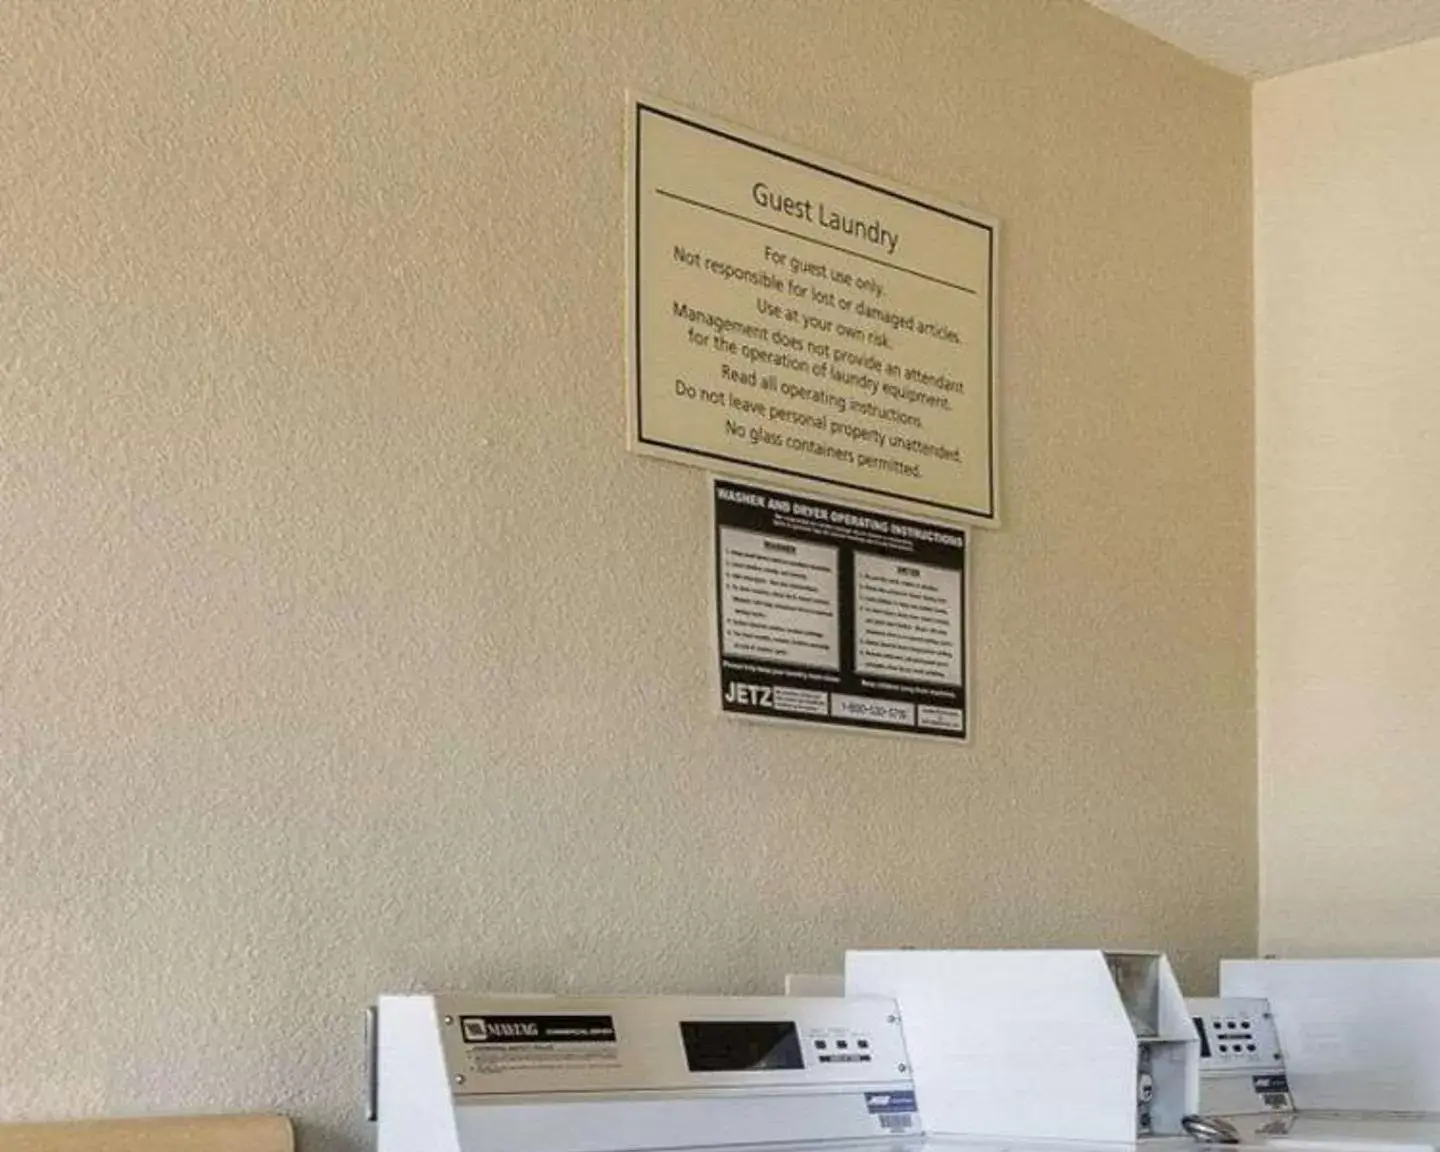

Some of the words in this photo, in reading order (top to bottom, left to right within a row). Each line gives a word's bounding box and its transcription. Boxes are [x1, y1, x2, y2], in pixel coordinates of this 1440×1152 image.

[752, 182, 813, 222] Guest
[818, 204, 899, 255] Laundry
[673, 245, 701, 268] Not
[704, 257, 785, 293] responsible
[788, 278, 808, 299] for
[811, 285, 836, 309] lost
[838, 297, 852, 311] or
[855, 301, 914, 331] damaged
[764, 245, 787, 266] For
[790, 256, 828, 279] guest
[830, 269, 852, 287] use
[673, 300, 768, 342] Management
[771, 331, 803, 351] does
[807, 342, 830, 359] not
[832, 348, 883, 372] provide
[885, 361, 901, 377] an
[757, 297, 782, 320] Use
[784, 307, 799, 323] at
[802, 313, 833, 333] your
[836, 323, 865, 341] own
[688, 327, 709, 347] for
[713, 333, 737, 355] the
[741, 343, 811, 372] operation
[812, 361, 828, 378] of
[830, 363, 880, 396] laundry
[721, 363, 757, 388] Read
[760, 374, 779, 392] all
[781, 382, 846, 413] operating
[675, 379, 697, 400] Do
[699, 388, 726, 408] not
[729, 391, 767, 418] leave
[768, 405, 828, 431] personal
[830, 421, 886, 448] property
[725, 418, 746, 439] No
[750, 426, 783, 447] glass
[785, 436, 855, 464] containers
[717, 487, 766, 508] WASHER
[767, 497, 792, 514] AND
[792, 502, 829, 520] DRYER
[830, 510, 889, 534] OPERATING
[890, 523, 963, 548] INSTRUCTIONS
[725, 681, 773, 708] JETZ
